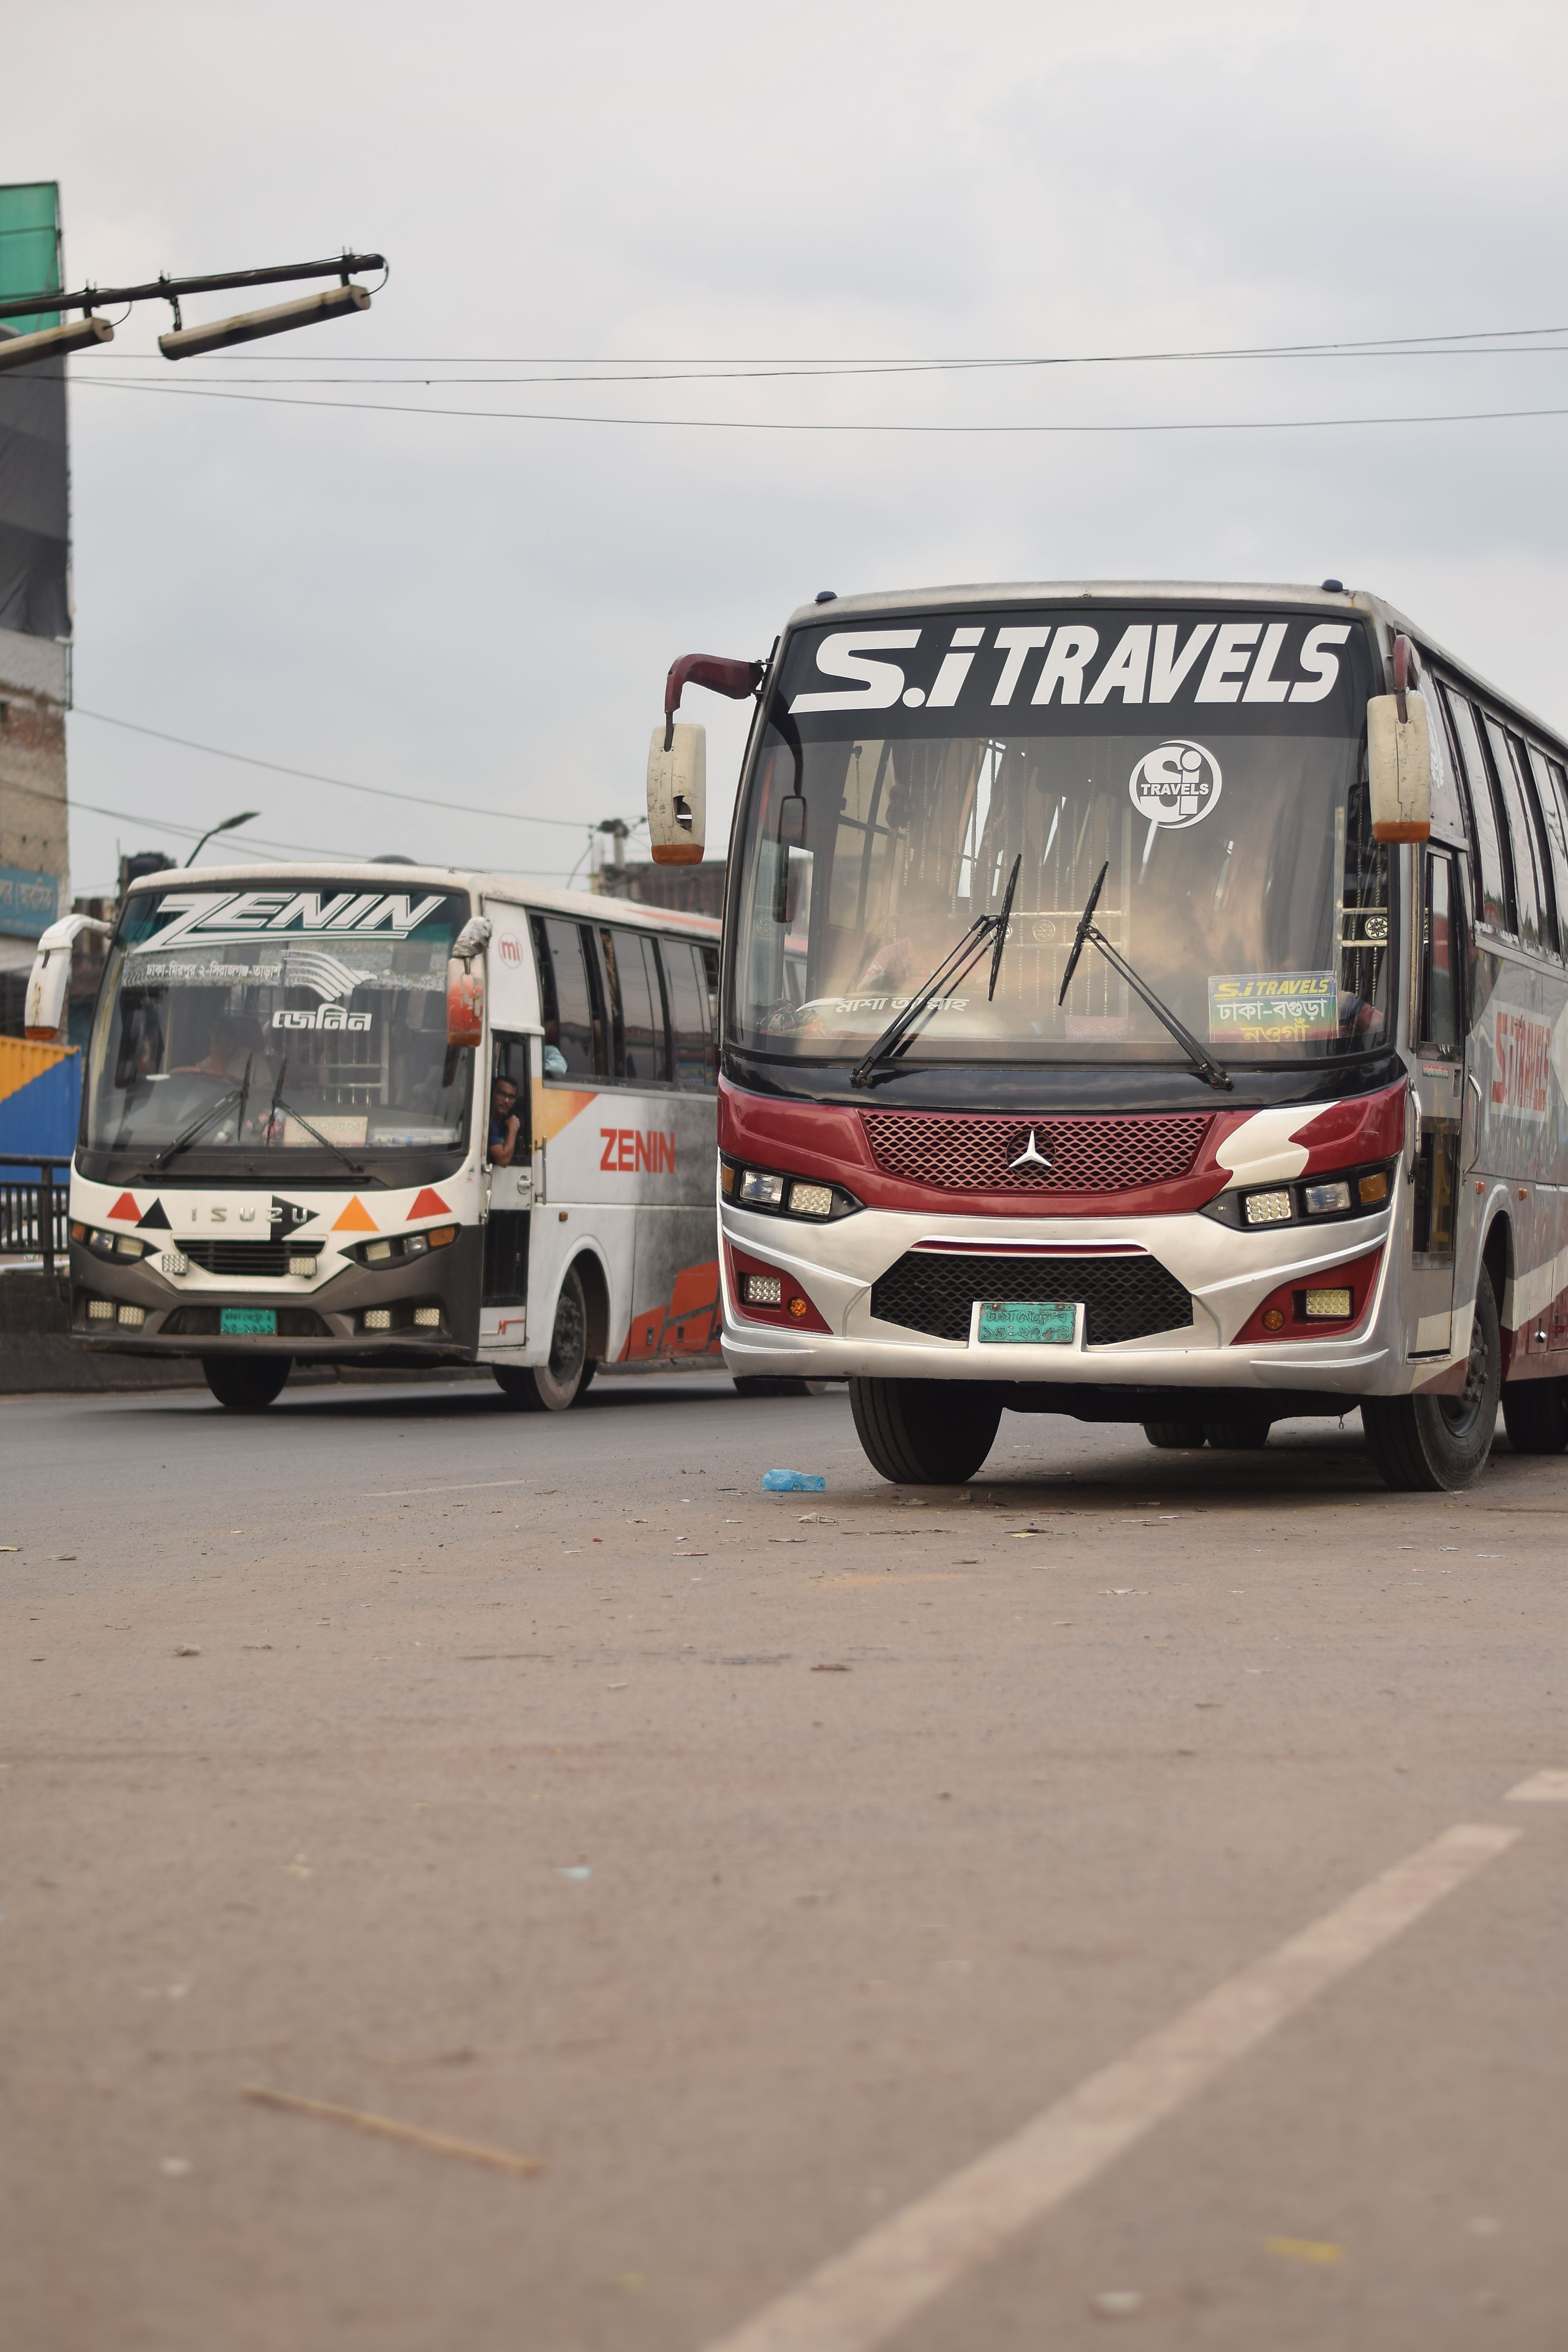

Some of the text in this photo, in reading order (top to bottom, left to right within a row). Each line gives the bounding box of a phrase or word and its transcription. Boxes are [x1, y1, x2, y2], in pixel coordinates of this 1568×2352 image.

[788, 623, 1352, 713] S.i TRAVELS
[1141, 784, 1209, 795] TRAVELS
[133, 893, 447, 954] ZENIN
[501, 941, 520, 962] mi
[1213, 979, 1330, 998] S.i TRAVELS
[835, 998, 889, 1013] মাশা
[1216, 998, 1328, 1021] ঢাকা-বগুড়া
[272, 1004, 372, 1031] জেনিন
[1240, 1017, 1310, 1043] নওগাঁ
[600, 1128, 675, 1174] ZENIN
[192, 1207, 308, 1223] ISUZU
[987, 1311, 1015, 1322] ঢাকা
